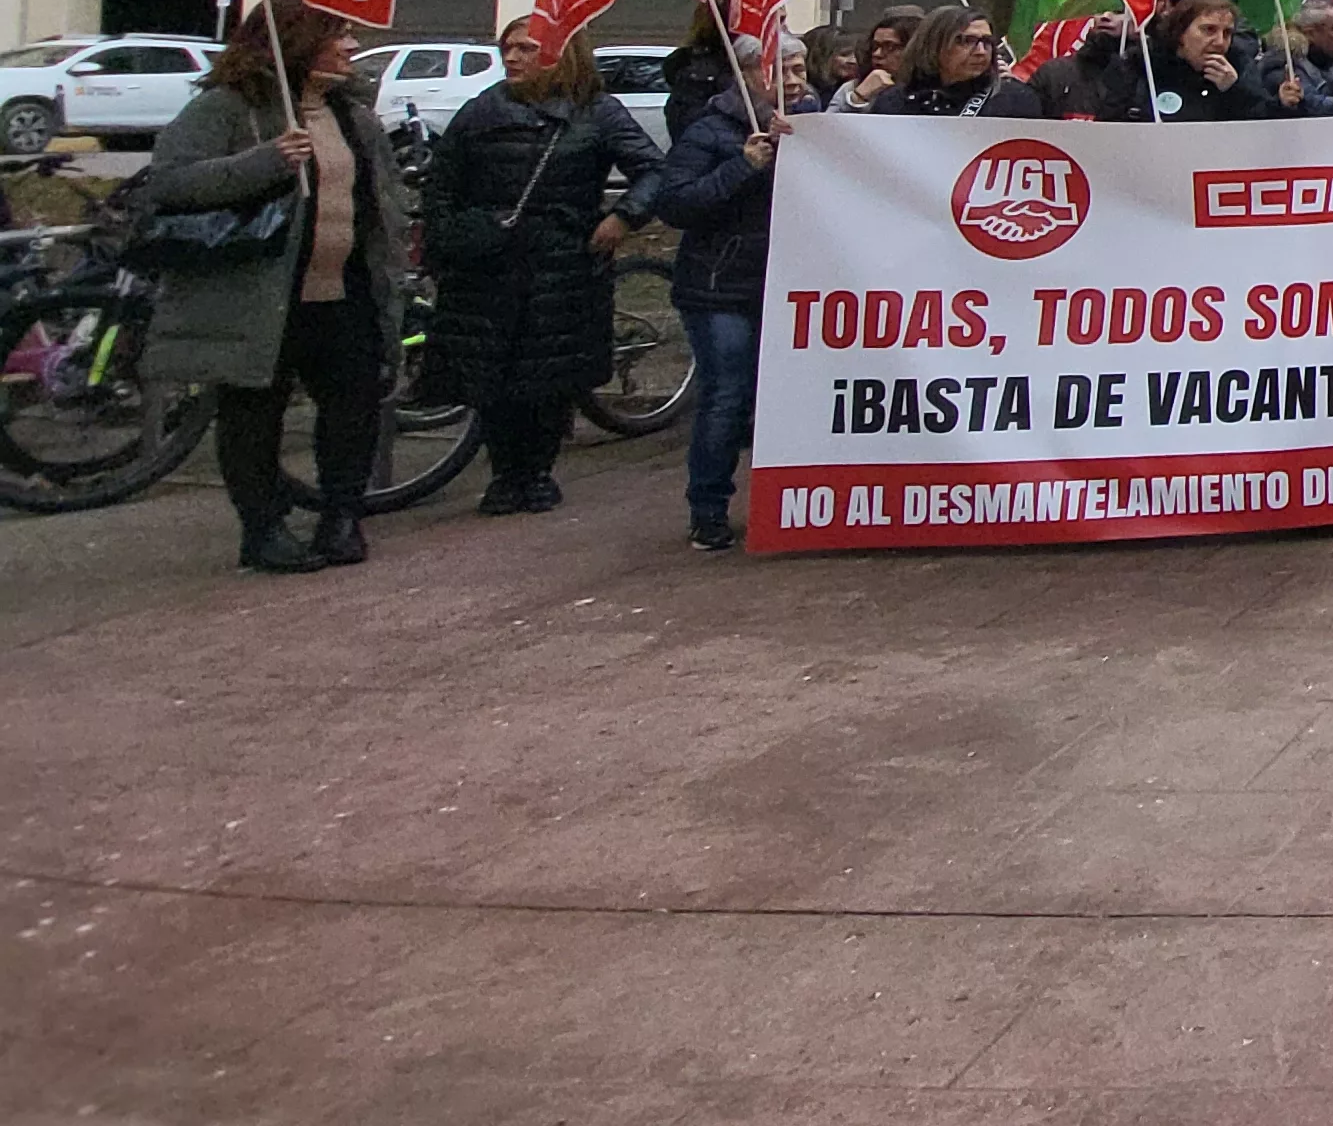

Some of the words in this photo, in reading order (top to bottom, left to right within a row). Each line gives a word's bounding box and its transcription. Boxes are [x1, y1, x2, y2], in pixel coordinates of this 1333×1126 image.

[969, 158, 1074, 205] UGT
[786, 289, 1007, 356] TODAS,
[1033, 285, 1226, 347] TODOS
[830, 375, 1032, 435] ¡BASTA
[1053, 373, 1127, 430] DE
[780, 486, 835, 529] NO
[846, 485, 891, 526] AL
[904, 470, 1290, 525] DESMANTELAMIENTO
